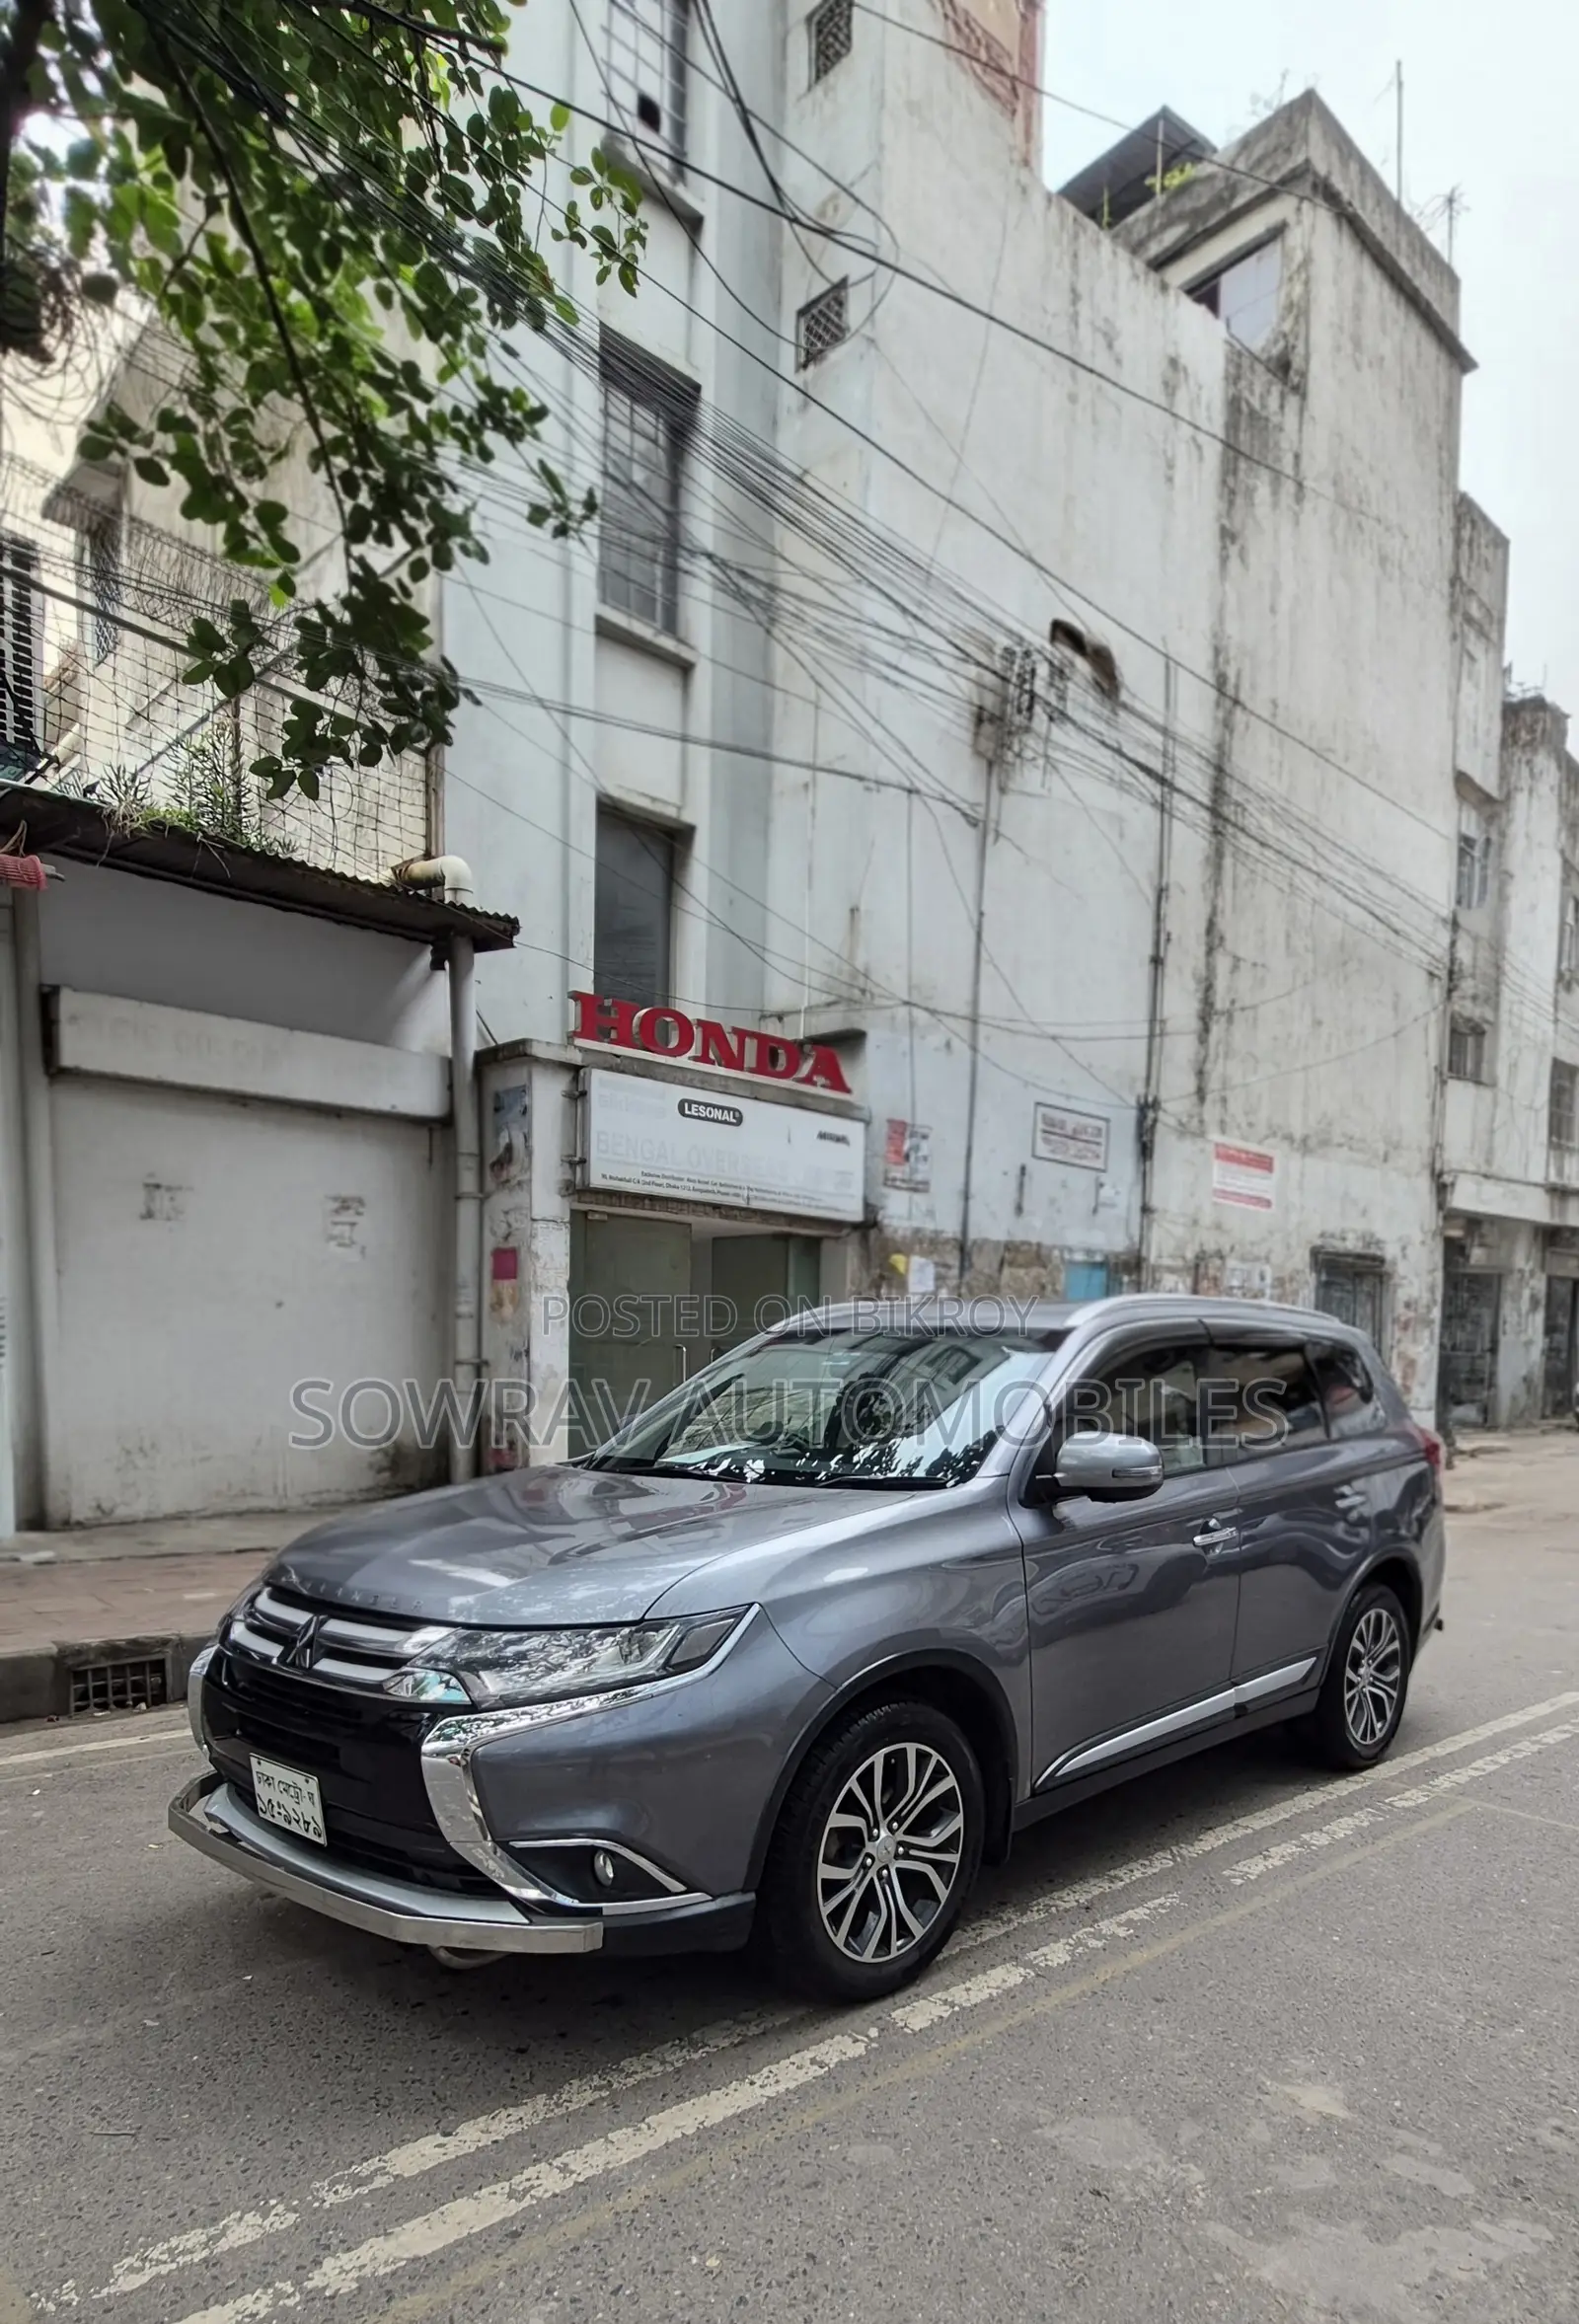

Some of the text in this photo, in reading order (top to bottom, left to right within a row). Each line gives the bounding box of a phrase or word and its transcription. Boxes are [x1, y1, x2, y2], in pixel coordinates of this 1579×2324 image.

[567, 990, 852, 1094] HONDA
[684, 1101, 738, 1123] LESONAL
[595, 1129, 681, 1167] BENGAL
[256, 1770, 275, 1793] ঢাকা
